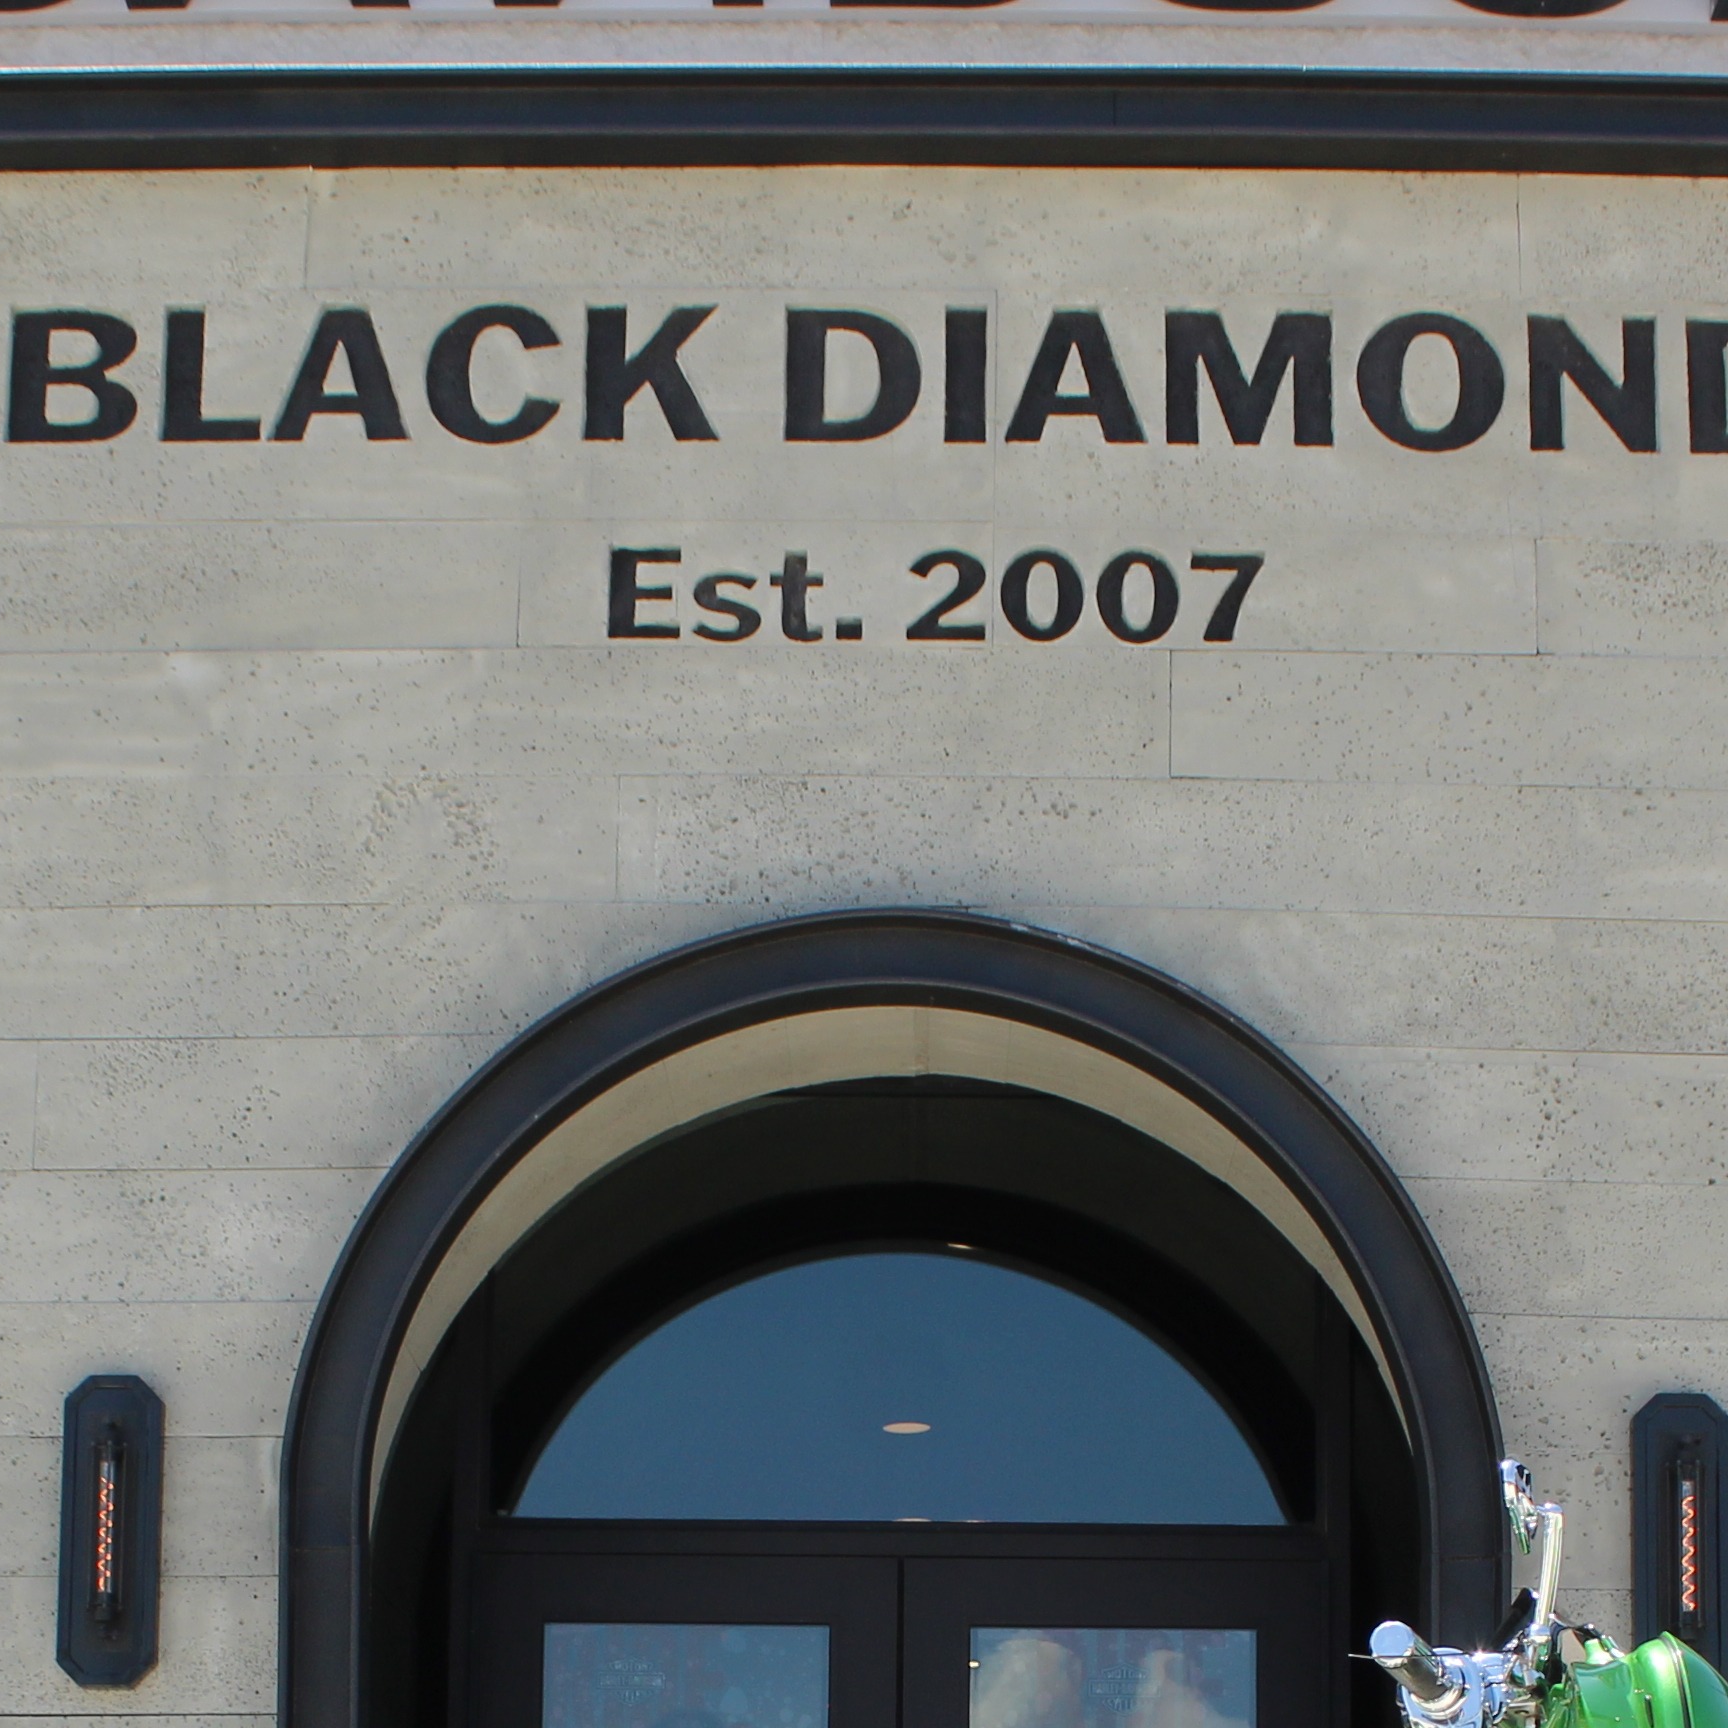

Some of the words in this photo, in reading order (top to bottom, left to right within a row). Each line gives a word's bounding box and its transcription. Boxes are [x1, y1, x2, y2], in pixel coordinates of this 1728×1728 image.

[5, 304, 720, 444] BLACK
[607, 548, 864, 642] Est.
[906, 550, 1265, 643] 2007
